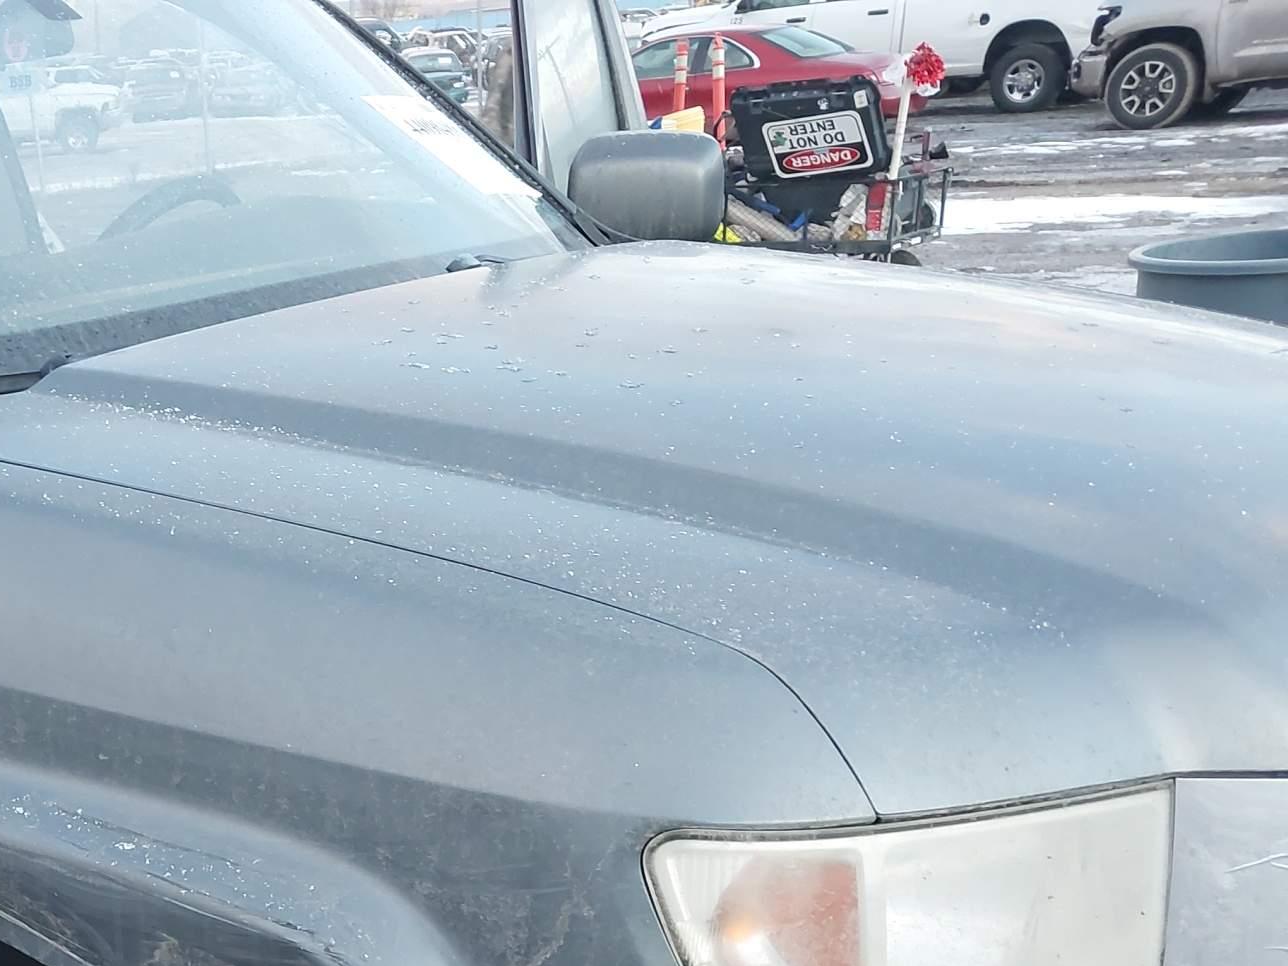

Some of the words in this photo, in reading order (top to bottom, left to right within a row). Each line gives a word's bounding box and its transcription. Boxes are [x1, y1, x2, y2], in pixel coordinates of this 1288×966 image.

[788, 120, 835, 135] ENTER
[788, 136, 818, 150] NOT
[823, 131, 845, 144] DO
[792, 150, 851, 167] DANGER
